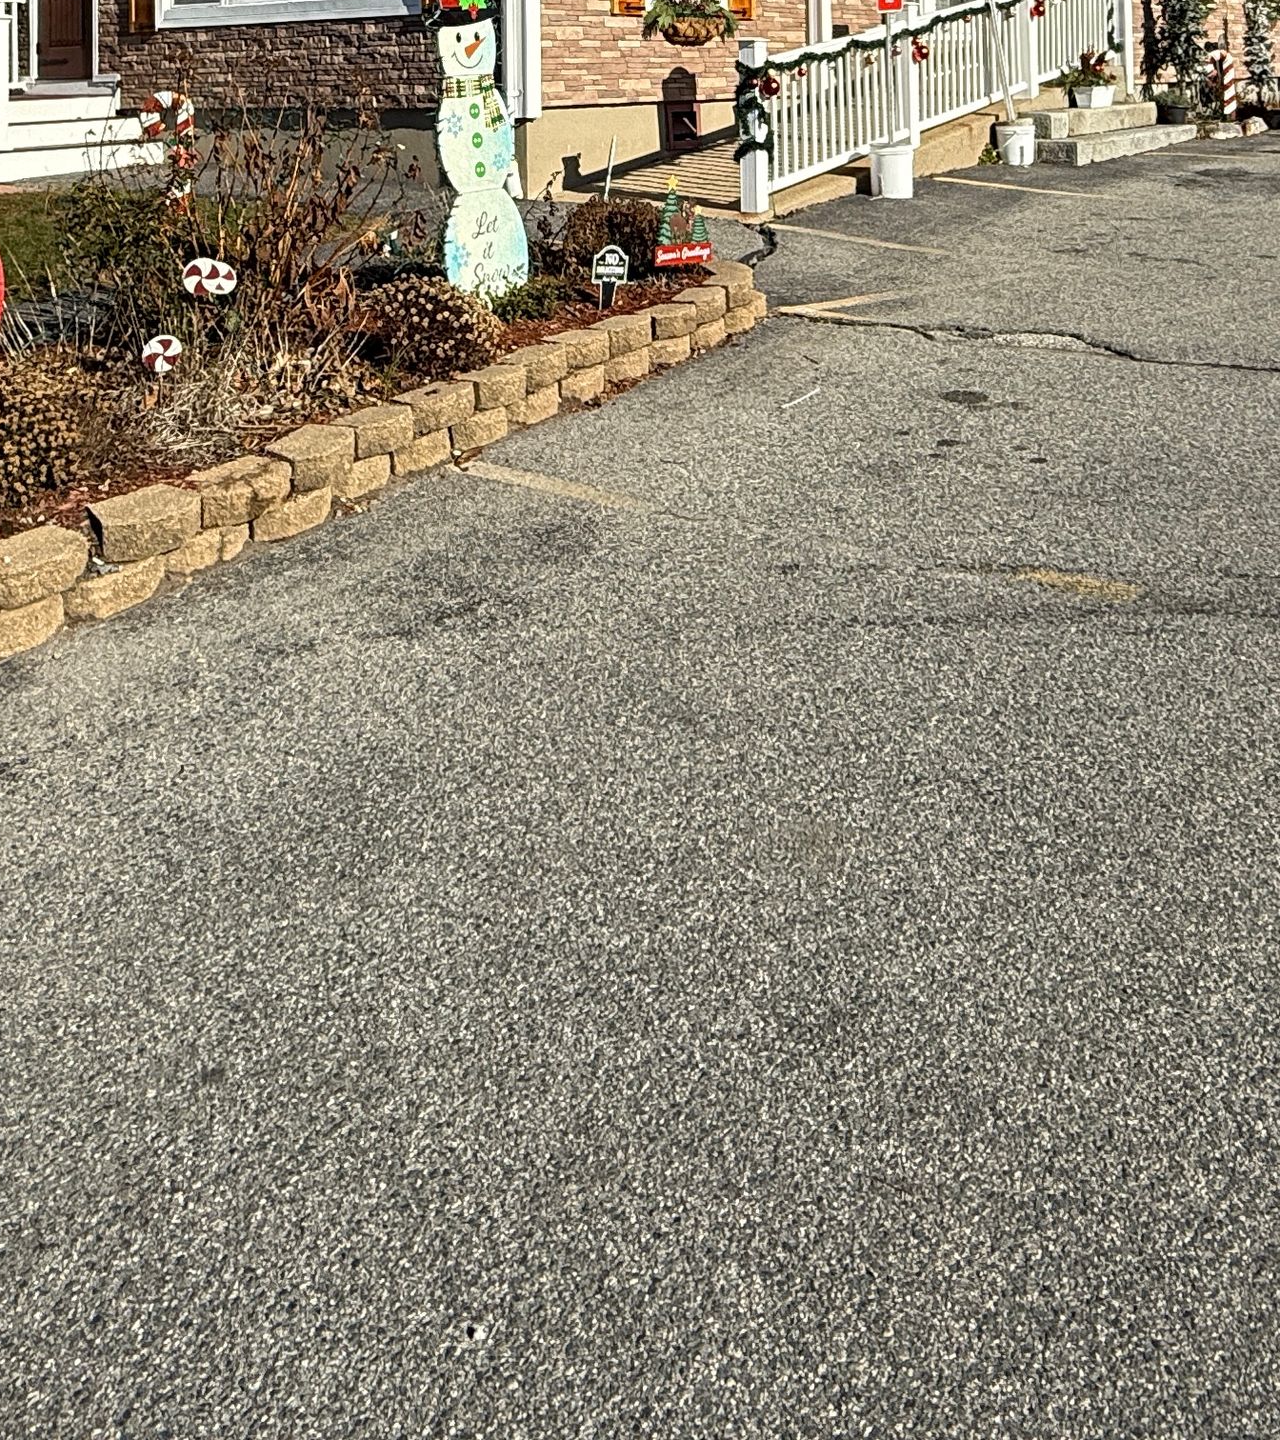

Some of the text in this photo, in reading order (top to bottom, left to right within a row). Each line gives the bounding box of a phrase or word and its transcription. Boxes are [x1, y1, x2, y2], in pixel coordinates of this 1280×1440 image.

[472, 211, 499, 239] Let
[483, 241, 495, 259] it
[605, 253, 619, 265] NO
